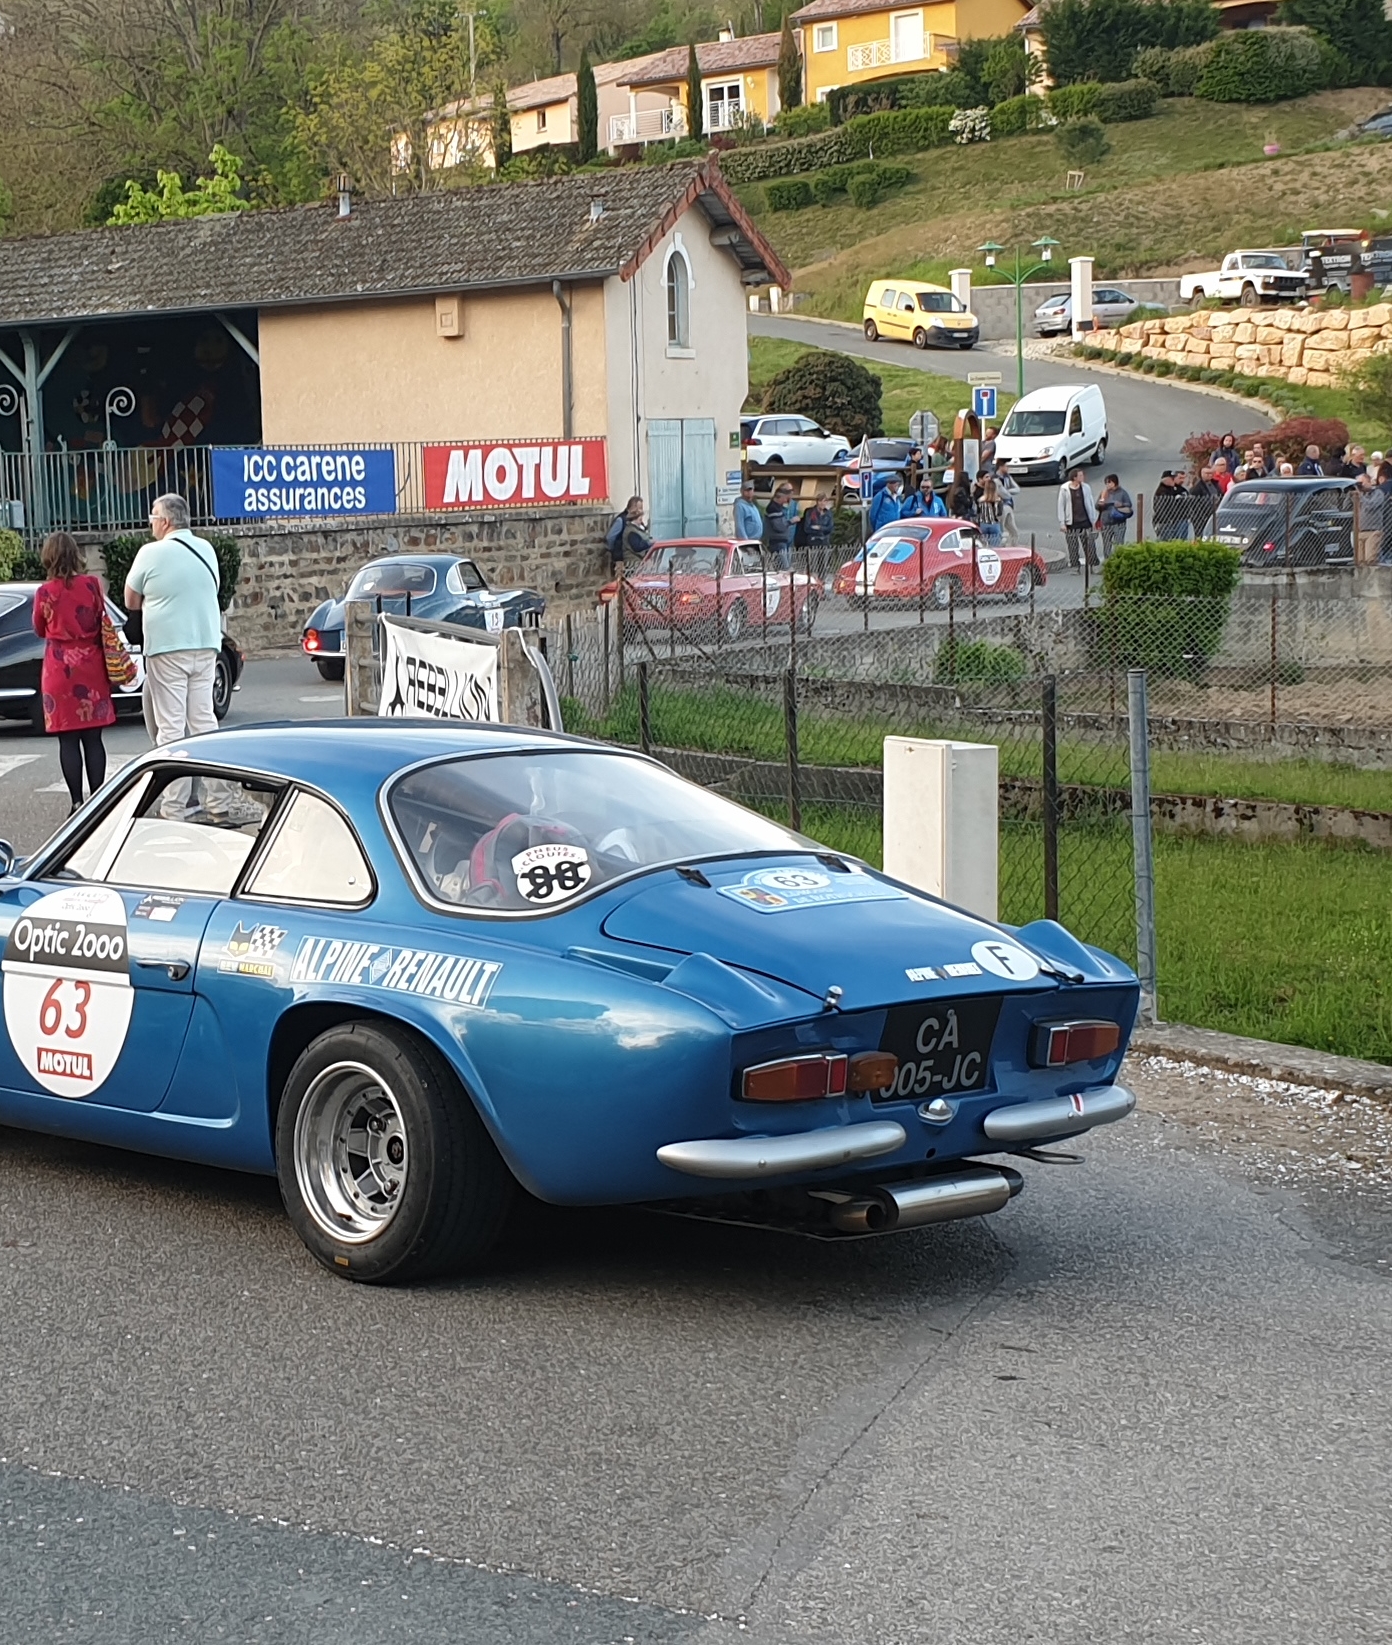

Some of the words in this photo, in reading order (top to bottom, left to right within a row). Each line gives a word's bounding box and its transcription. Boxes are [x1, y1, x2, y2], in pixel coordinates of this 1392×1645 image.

[280, 454, 366, 482] carene
[442, 445, 590, 503] MOTUL
[243, 486, 366, 512] assurances
[773, 874, 819, 888] 63
[13, 918, 69, 961] Optic
[294, 937, 381, 983] ALPINE
[385, 950, 501, 1006] RENAULT
[985, 946, 1015, 975] F
[39, 978, 91, 1038] 63
[39, 1052, 92, 1078] MOTUL
